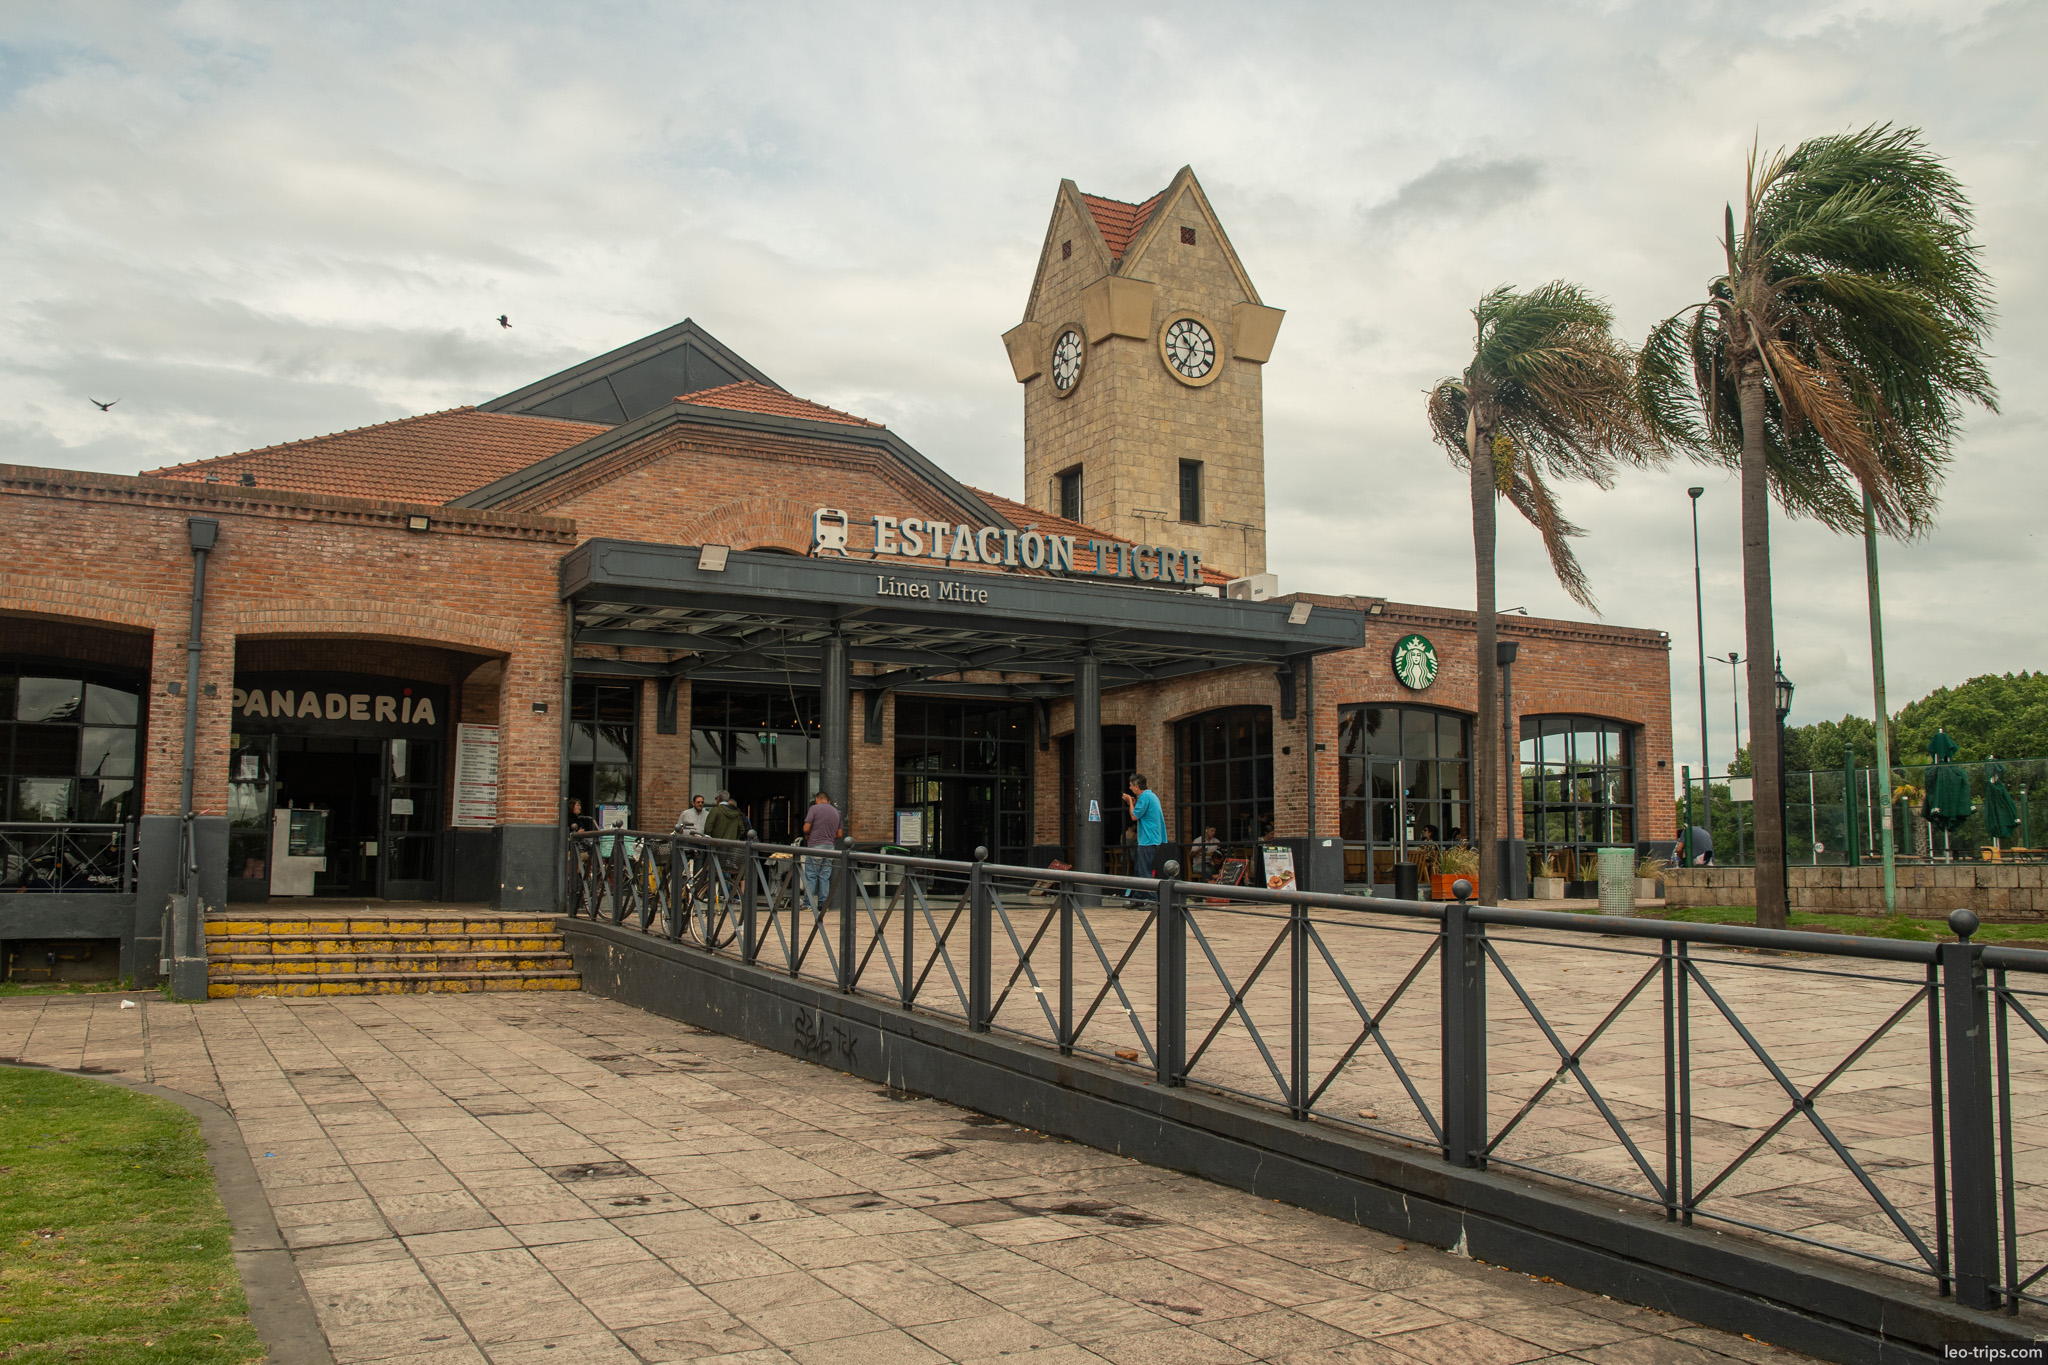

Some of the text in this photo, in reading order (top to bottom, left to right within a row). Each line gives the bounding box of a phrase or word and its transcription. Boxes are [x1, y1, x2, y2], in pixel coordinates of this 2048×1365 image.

[872, 515, 1204, 584] ESTACIÓN TIGRE
[877, 575, 988, 604] Línea Mitre
